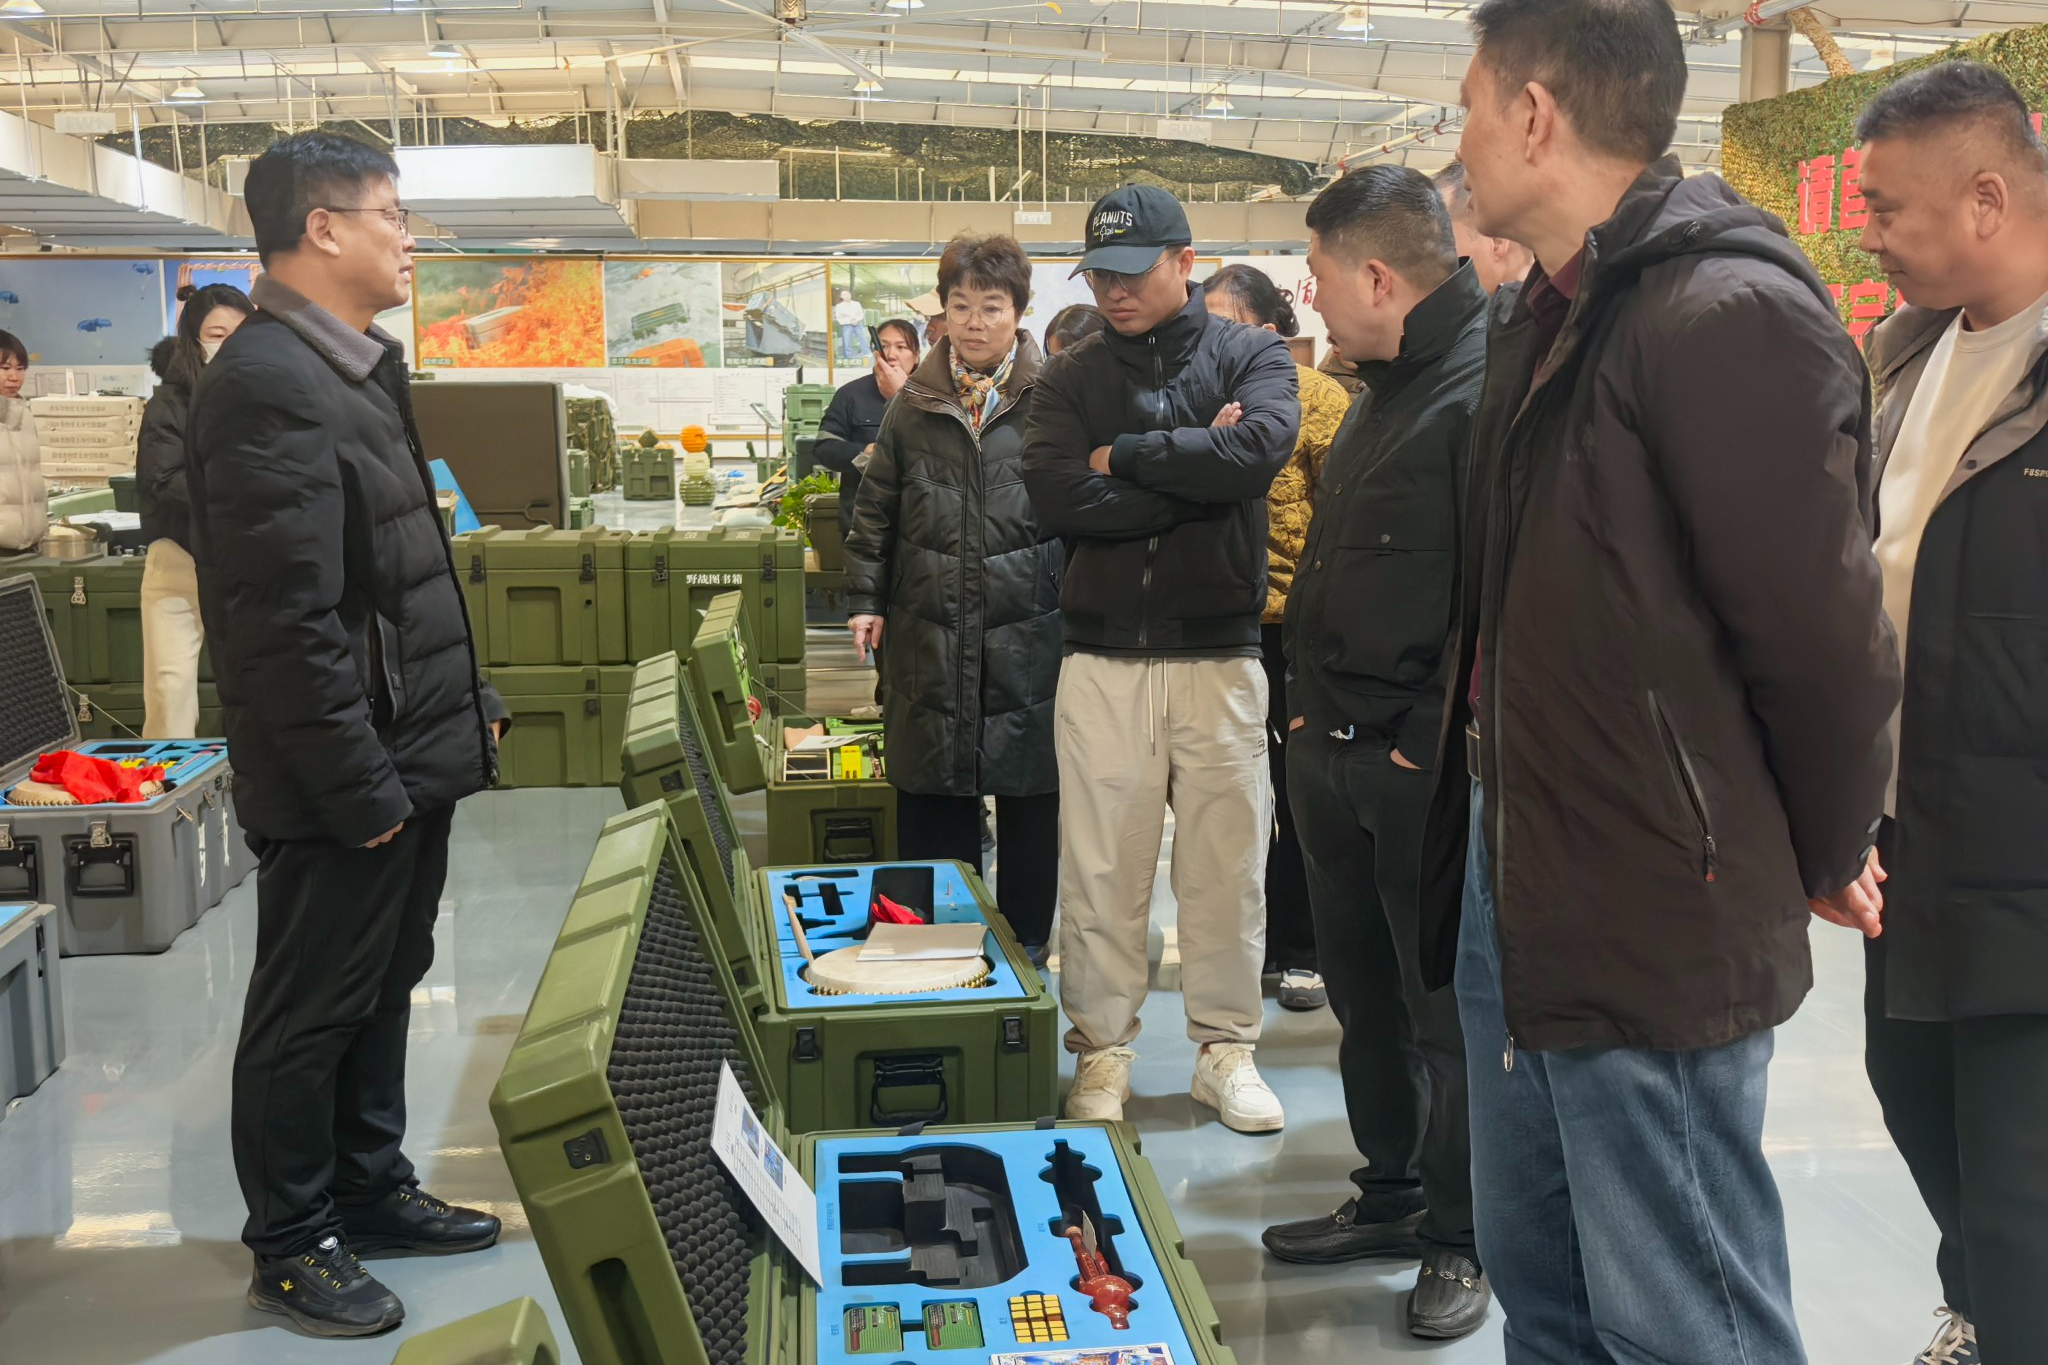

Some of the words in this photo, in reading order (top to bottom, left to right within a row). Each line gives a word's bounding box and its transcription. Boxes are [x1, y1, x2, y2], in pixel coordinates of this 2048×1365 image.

[686, 573, 743, 585] 野战图书箱
